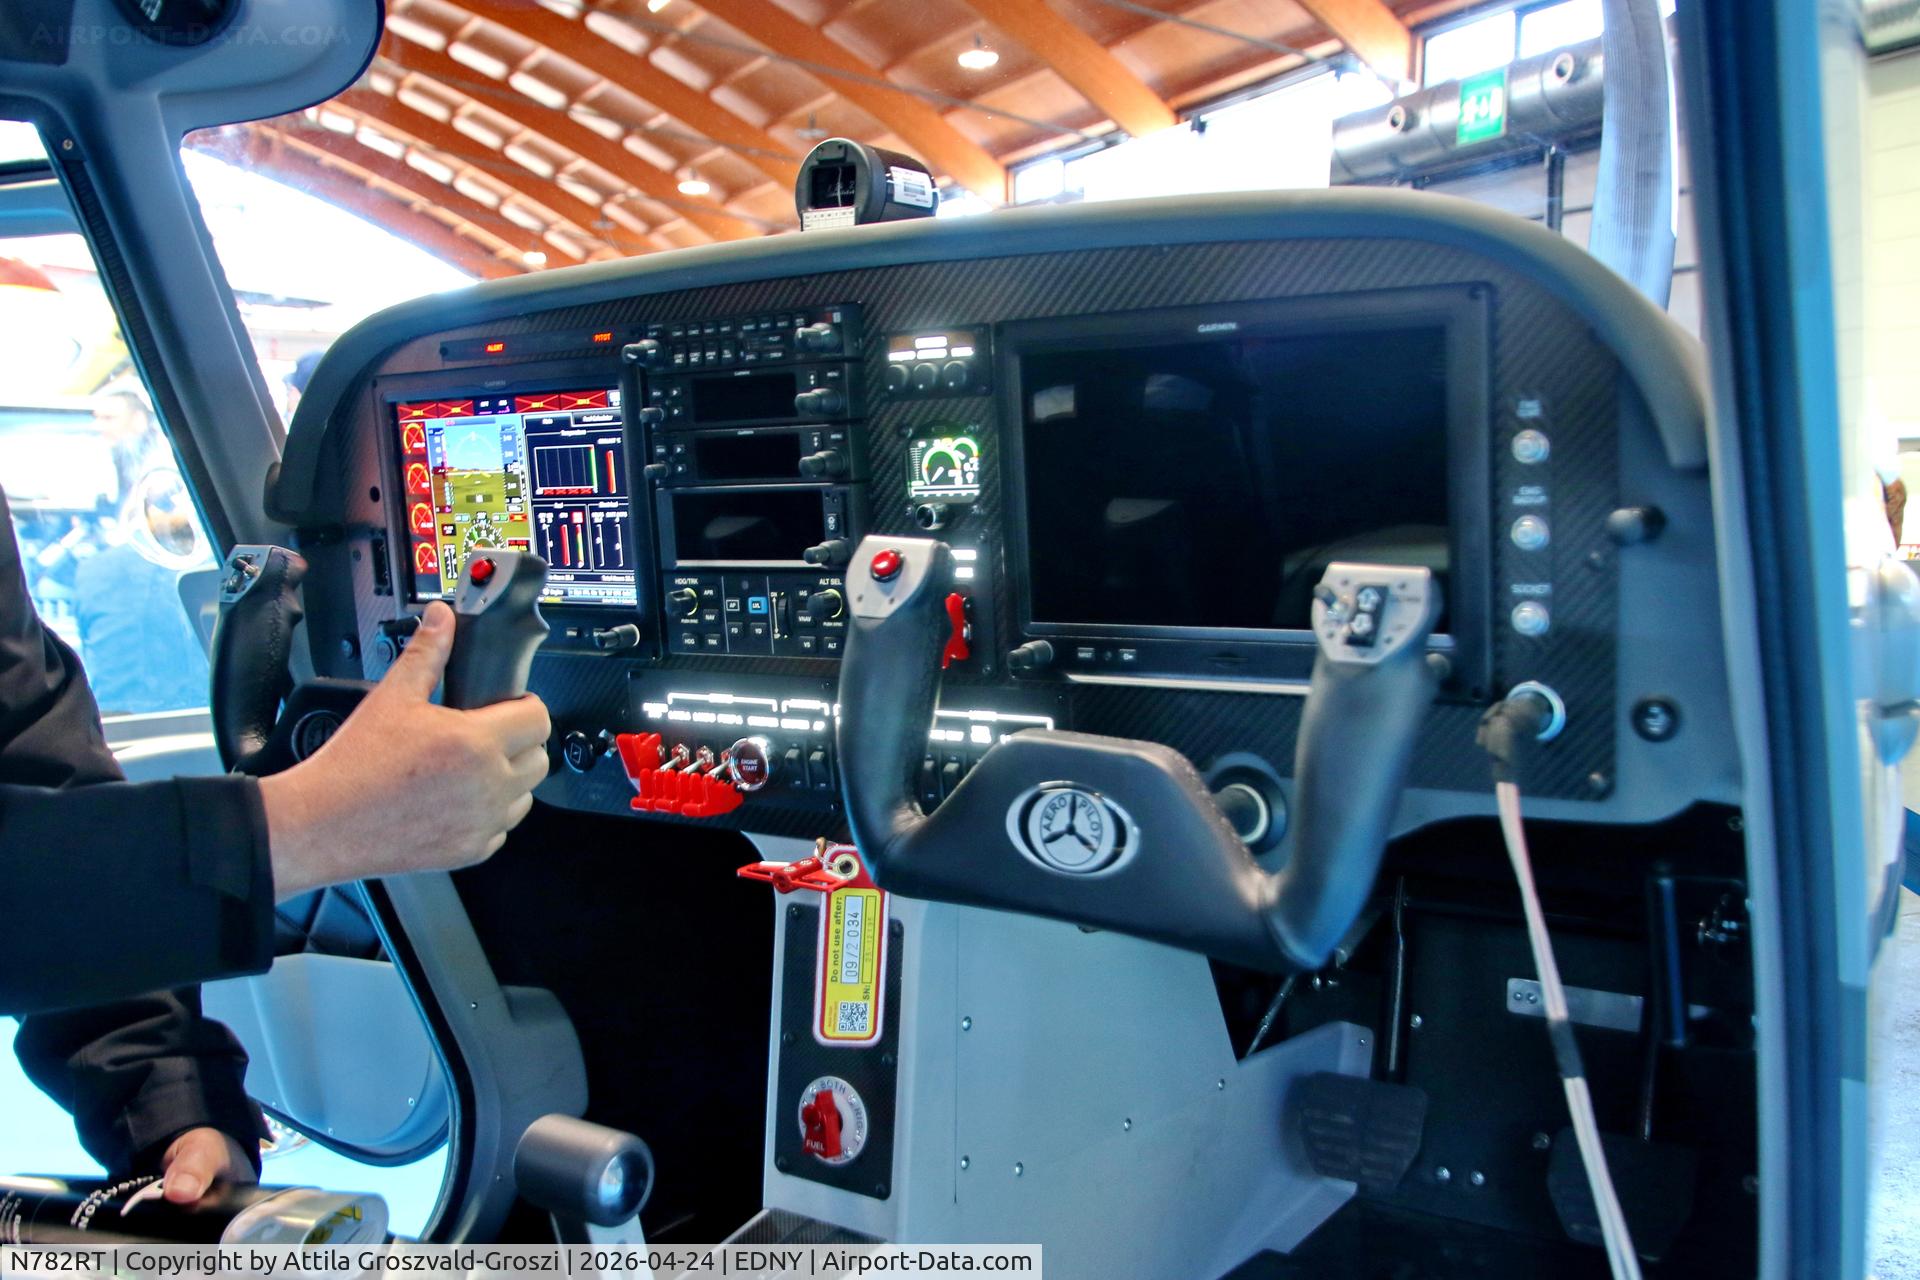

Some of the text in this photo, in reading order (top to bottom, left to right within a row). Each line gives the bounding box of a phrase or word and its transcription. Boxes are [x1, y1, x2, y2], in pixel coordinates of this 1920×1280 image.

[486, 343, 503, 352] ALERT
[1043, 796, 1068, 833] AERO
[1078, 800, 1100, 842] PILOT
[831, 970, 838, 983] Do
[835, 896, 843, 926] after:
[820, 1079, 846, 1094] BOTH
[806, 1139, 825, 1151] FUEL
